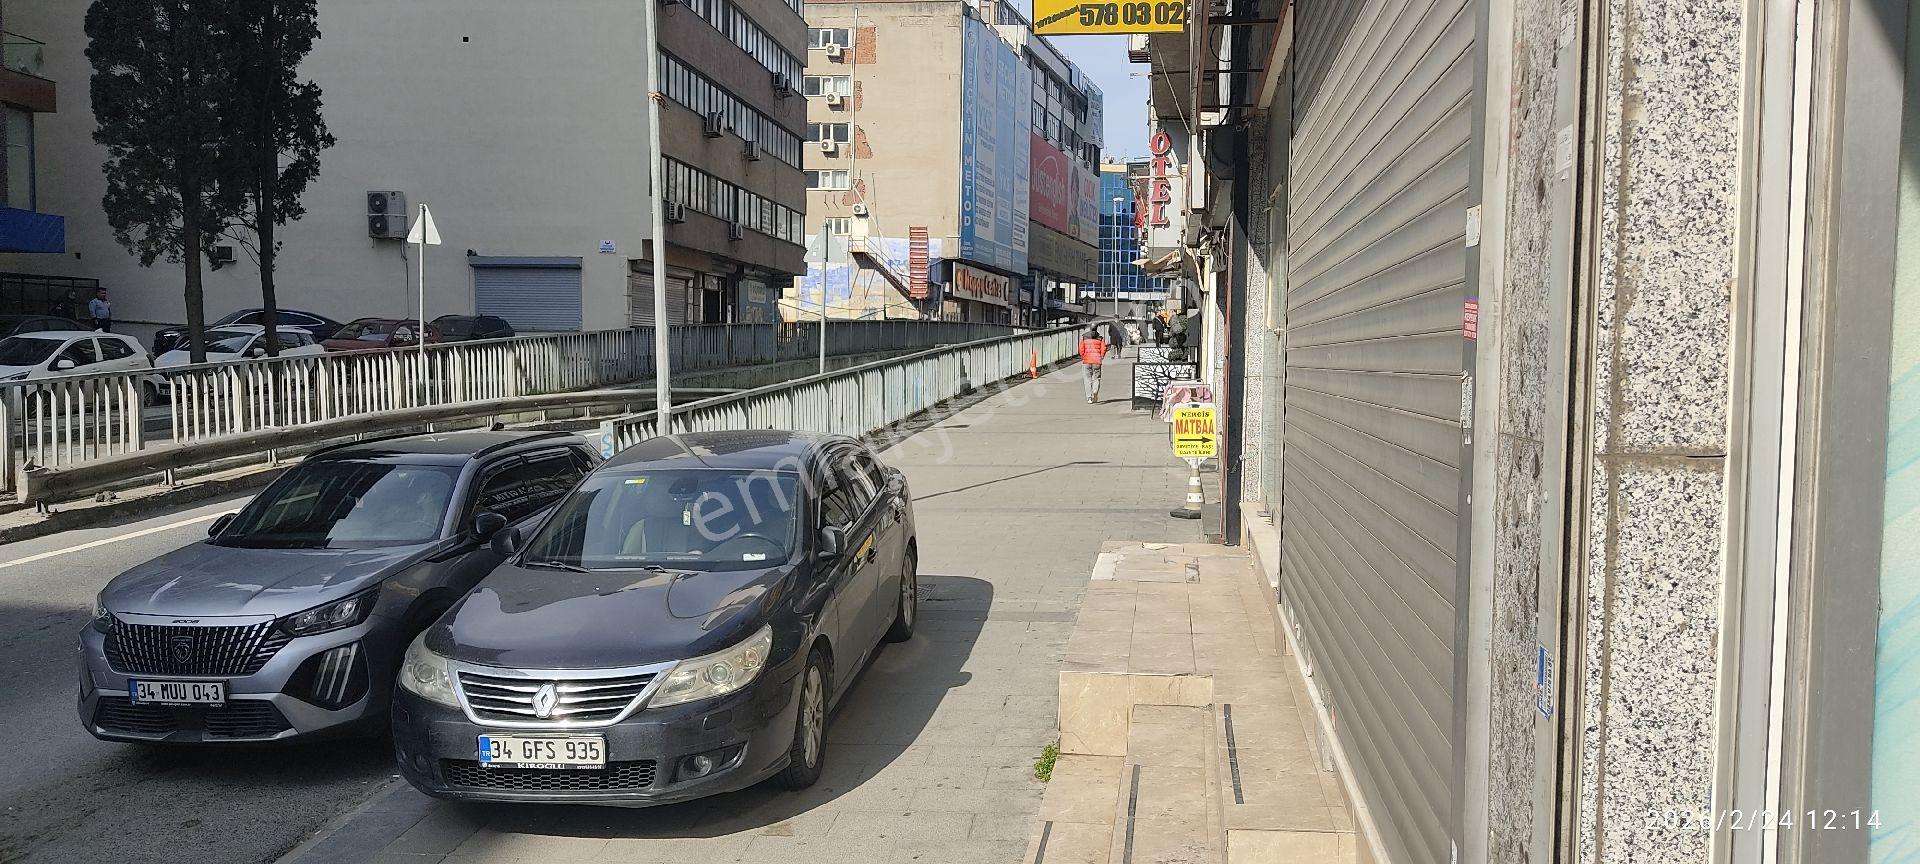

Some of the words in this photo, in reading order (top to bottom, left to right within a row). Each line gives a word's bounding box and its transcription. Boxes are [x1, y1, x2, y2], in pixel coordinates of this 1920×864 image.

[1080, 2, 1119, 26] 578
[1123, 2, 1151, 25] 03
[1155, 2, 1183, 25] 02
[963, 155, 973, 227] METOD
[1175, 419, 1214, 435] MATBAA
[138, 684, 156, 699] 34
[160, 683, 187, 700] MUU
[192, 684, 220, 700] 043
[490, 740, 513, 759] 34
[522, 740, 556, 760] GFS
[565, 741, 600, 760] 935
